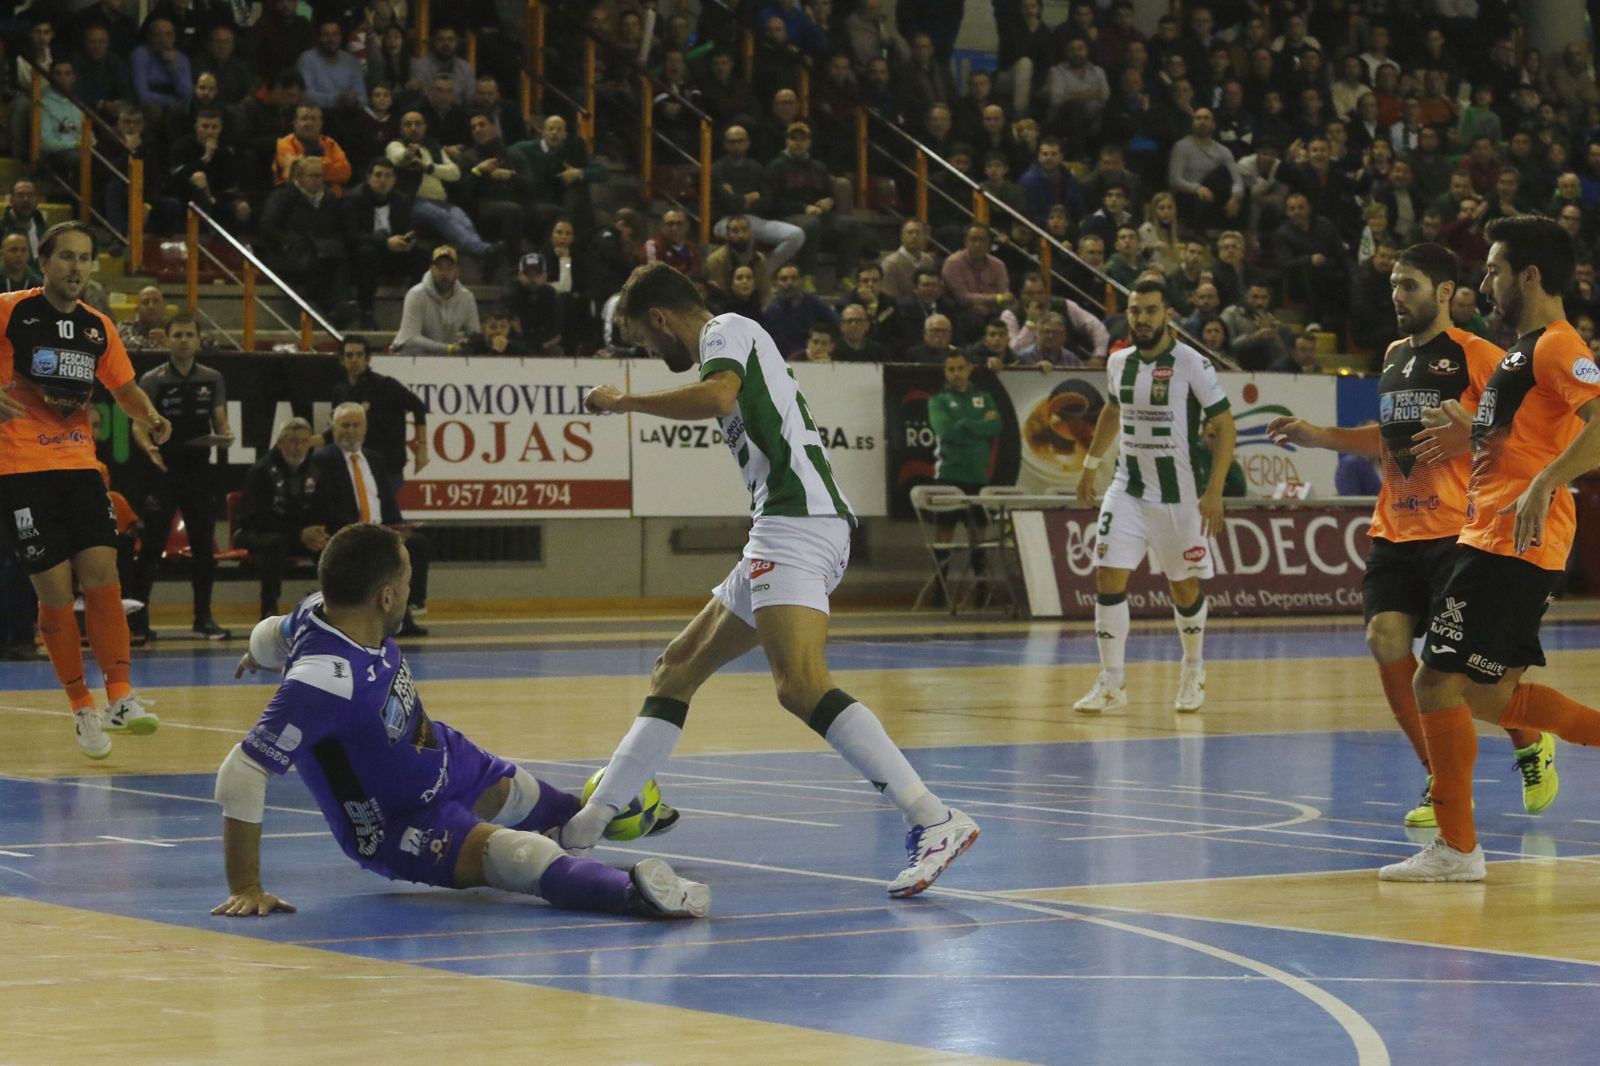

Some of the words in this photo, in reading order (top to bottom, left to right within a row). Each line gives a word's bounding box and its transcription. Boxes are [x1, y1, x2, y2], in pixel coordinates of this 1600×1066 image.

[56, 319, 74, 339] 10
[1401, 355, 1416, 378] 4
[1396, 391, 1440, 408] PESCADOS
[1394, 406, 1425, 421] RUB
[404, 420, 594, 464] OJAS
[420, 484, 442, 506] T.
[447, 484, 489, 506] 957
[491, 484, 531, 506] 202
[533, 484, 572, 506] 794
[1098, 511, 1114, 536] 3
[1235, 590, 1256, 607] de
[1258, 589, 1333, 609] Deportes
